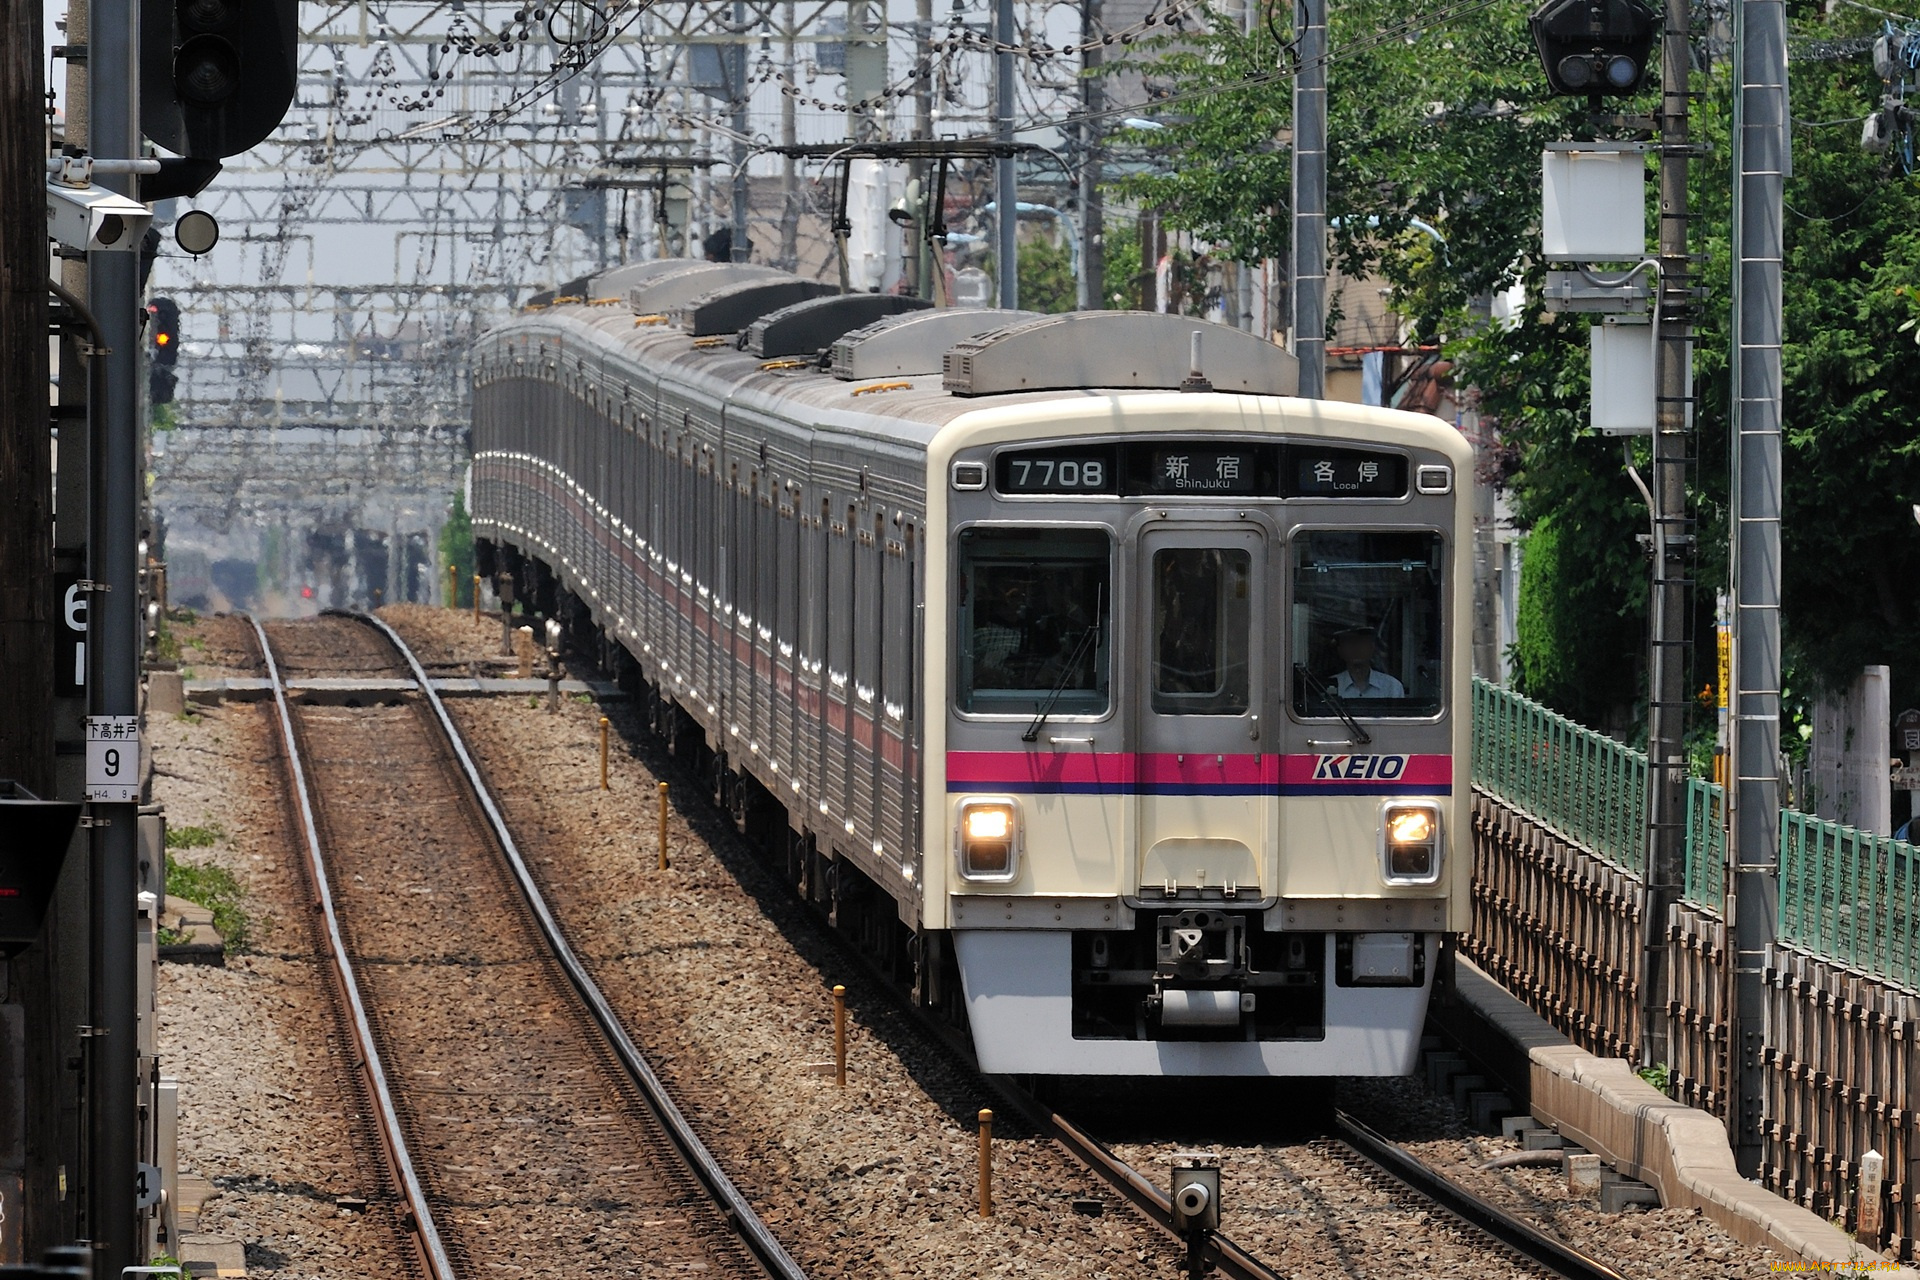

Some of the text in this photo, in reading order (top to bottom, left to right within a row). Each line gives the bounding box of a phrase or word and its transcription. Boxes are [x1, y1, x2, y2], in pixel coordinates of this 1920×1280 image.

[1012, 461, 1103, 486] 7708
[1166, 455, 1240, 479] 新宿
[1314, 461, 1379, 483] 各停
[1333, 482, 1359, 490] Local
[88, 722, 137, 739] 下高井戸
[104, 748, 119, 777] 9
[1316, 755, 1405, 779] KEIO
[122, 789, 127, 799] 9
